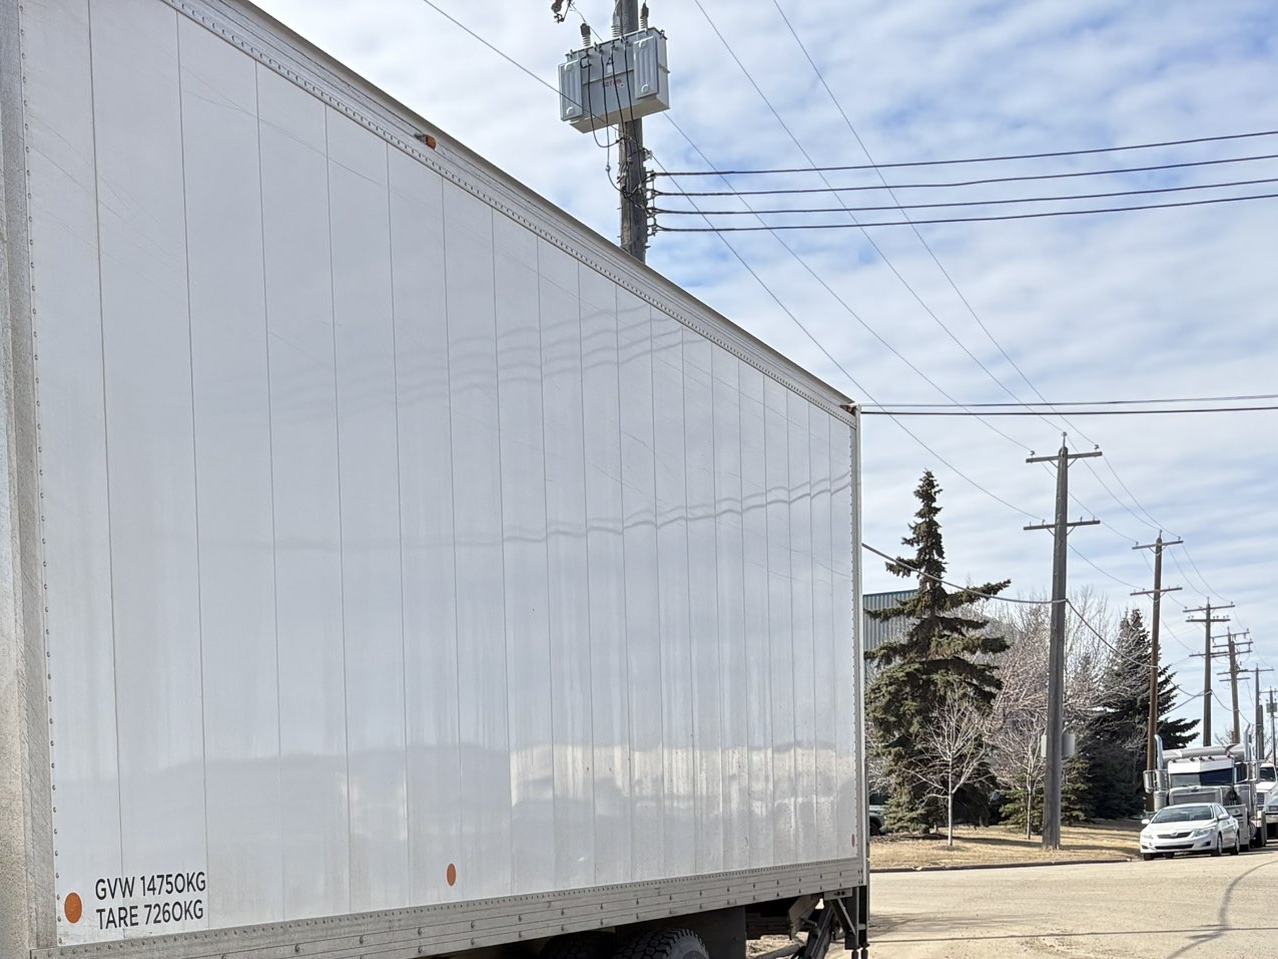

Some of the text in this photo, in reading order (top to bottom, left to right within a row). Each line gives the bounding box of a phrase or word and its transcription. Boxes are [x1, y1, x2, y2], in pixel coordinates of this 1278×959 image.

[95, 871, 206, 900] GVW 14750KG
[96, 899, 204, 929] TARE 7260KG
